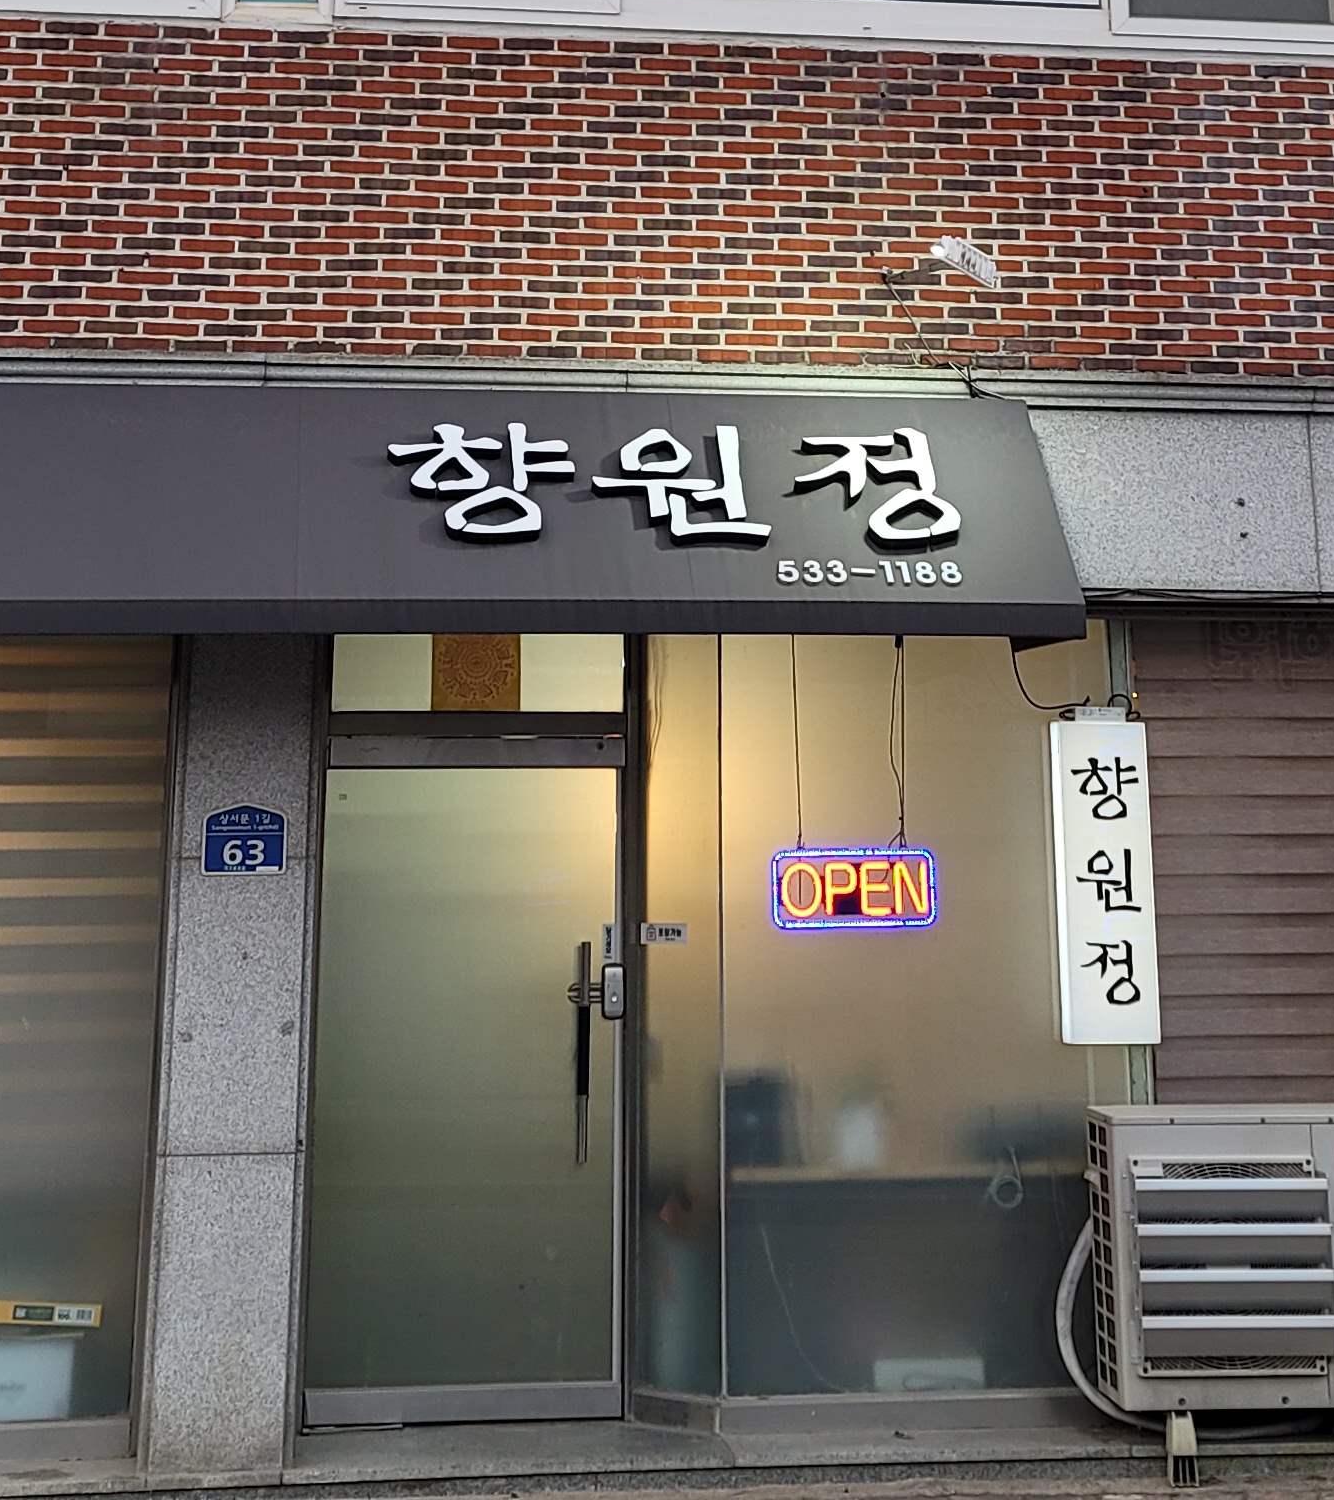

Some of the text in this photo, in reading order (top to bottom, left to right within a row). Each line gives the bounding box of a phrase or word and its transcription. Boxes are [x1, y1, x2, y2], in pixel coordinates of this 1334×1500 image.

[386, 421, 963, 551] 향원정
[776, 558, 964, 587] 533-1188
[223, 839, 265, 865] 63
[1070, 756, 1143, 1006] 향원정
[780, 860, 930, 918] OPEN
